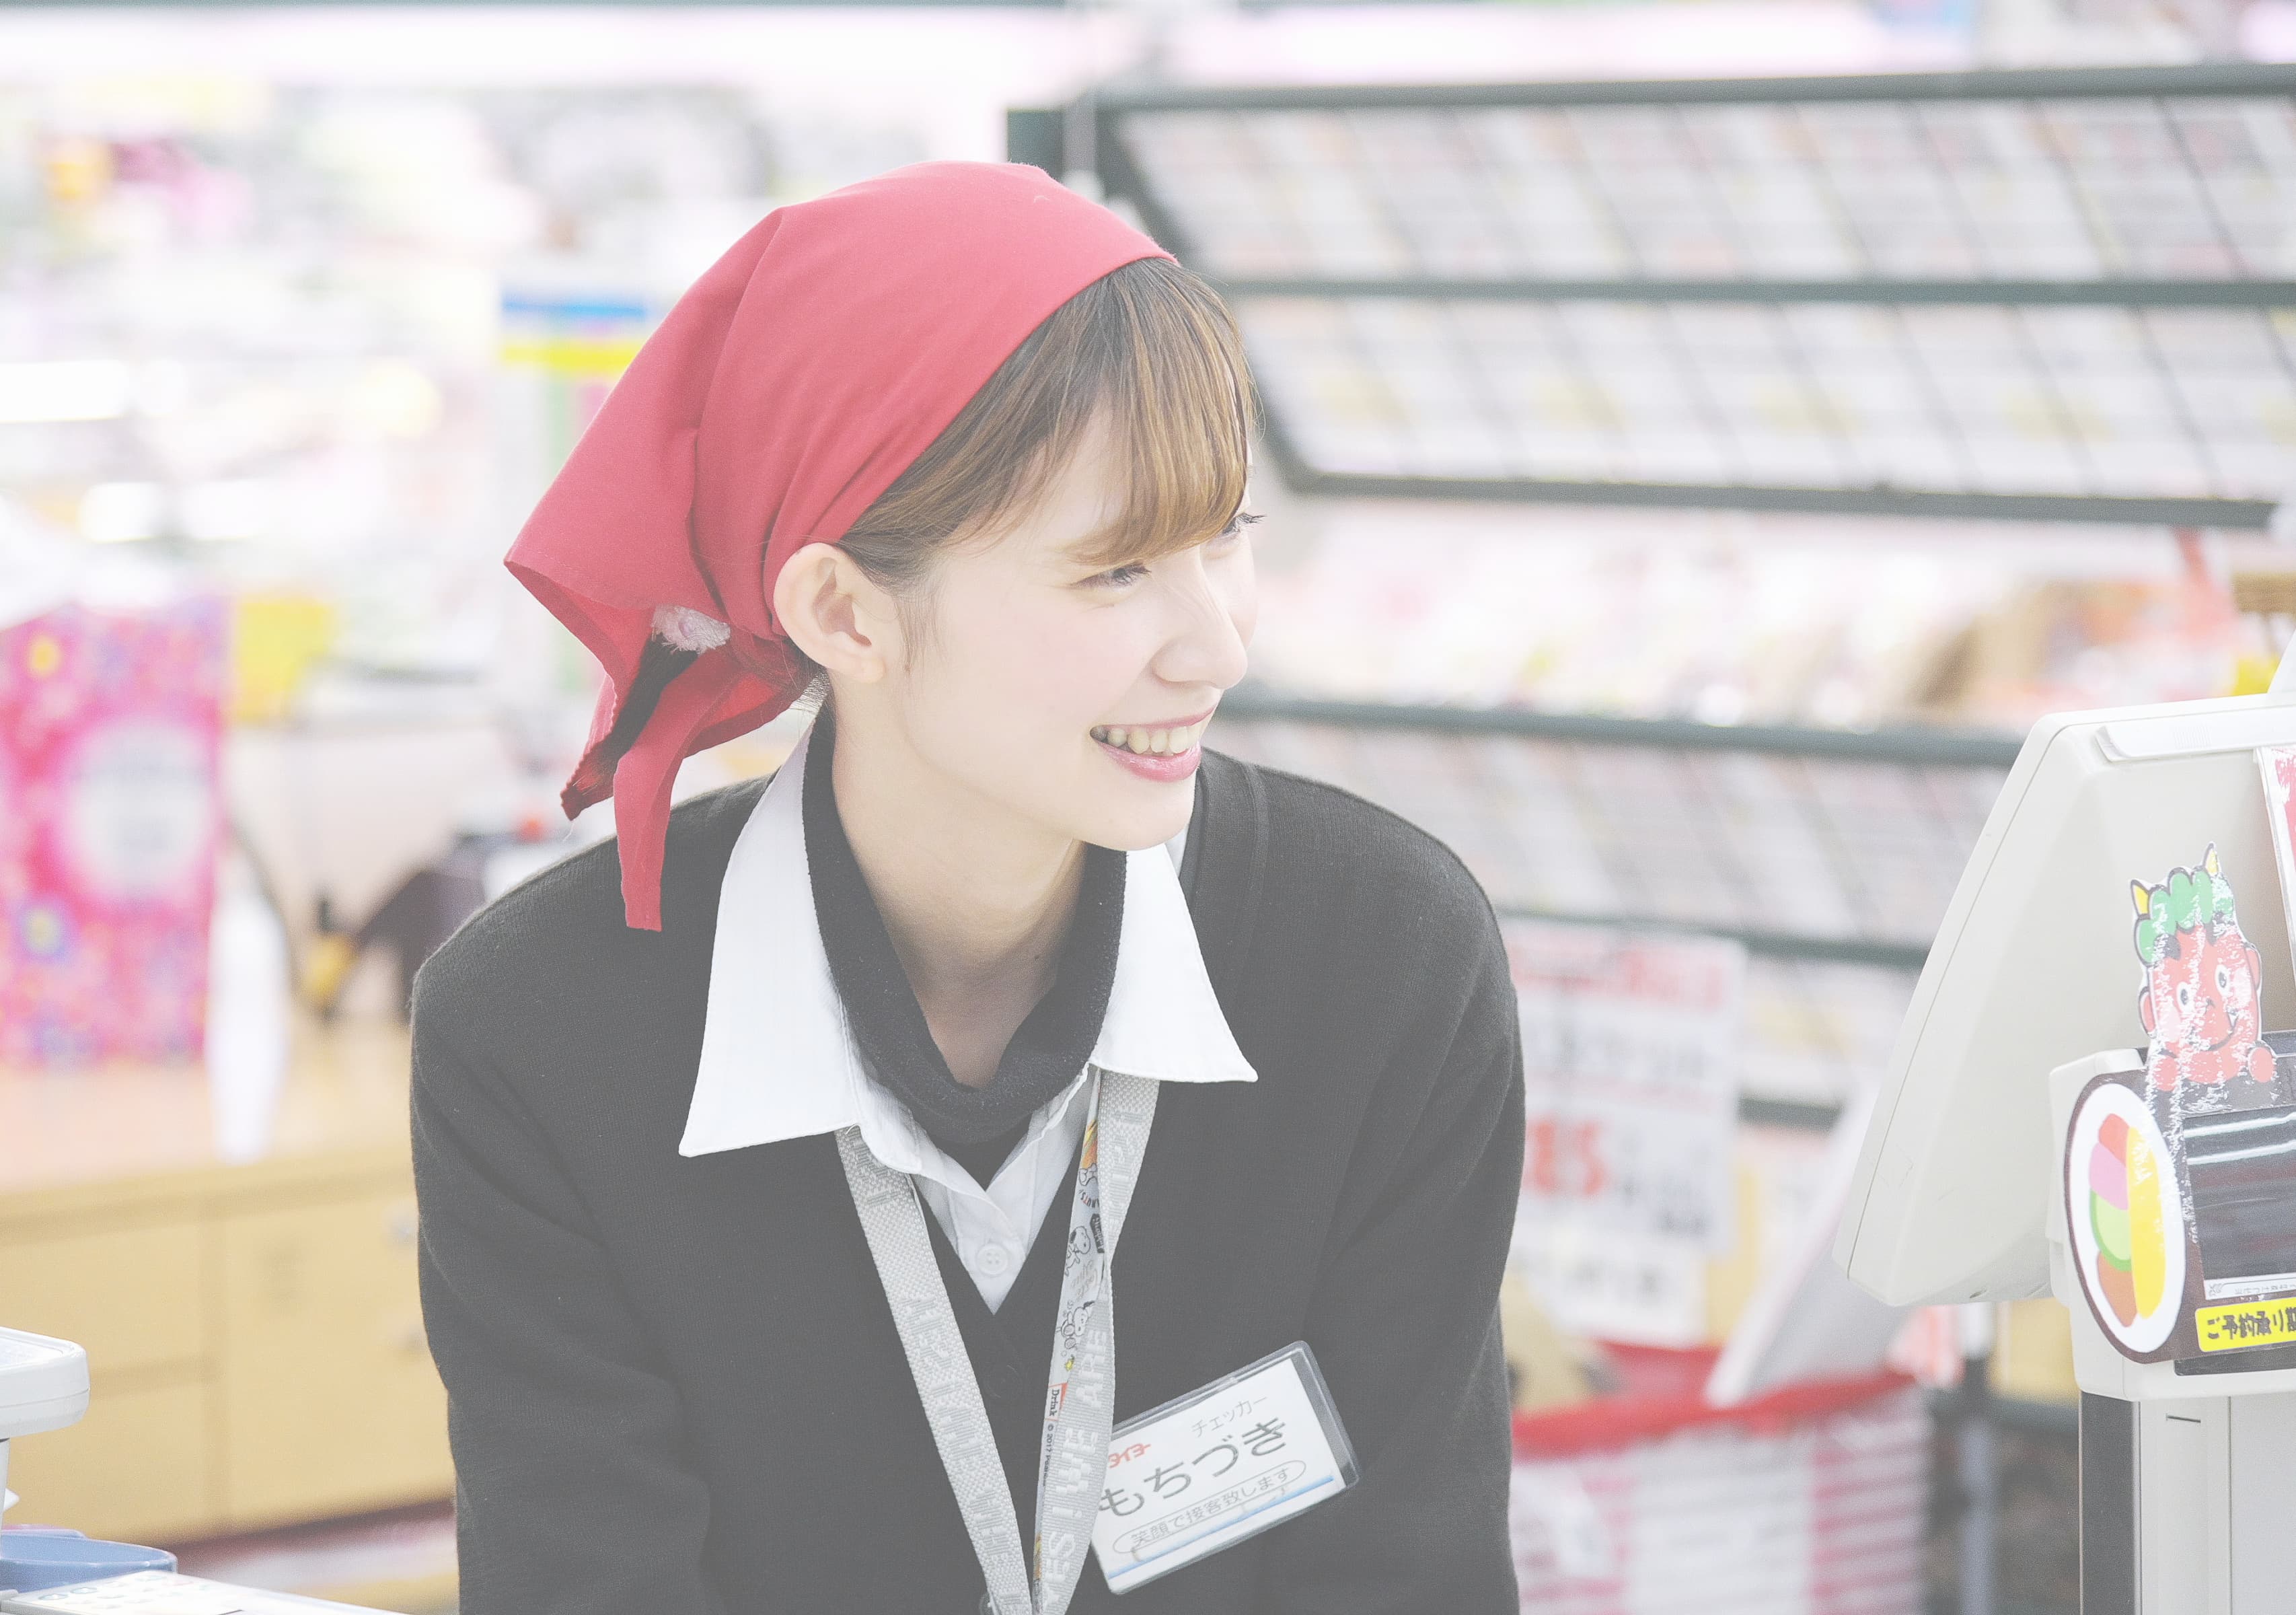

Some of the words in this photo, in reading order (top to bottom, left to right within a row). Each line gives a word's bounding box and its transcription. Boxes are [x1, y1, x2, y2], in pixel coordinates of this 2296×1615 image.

[1049, 1389, 1060, 1416] Drink
[1074, 1329, 1109, 1410] ARE
[1191, 1396, 1267, 1438] チェッカー
[1055, 1427, 1099, 1499] WE
[1099, 1417, 1286, 1516] もちづき
[1130, 1467, 1290, 1546] 笑顔で接客致します
